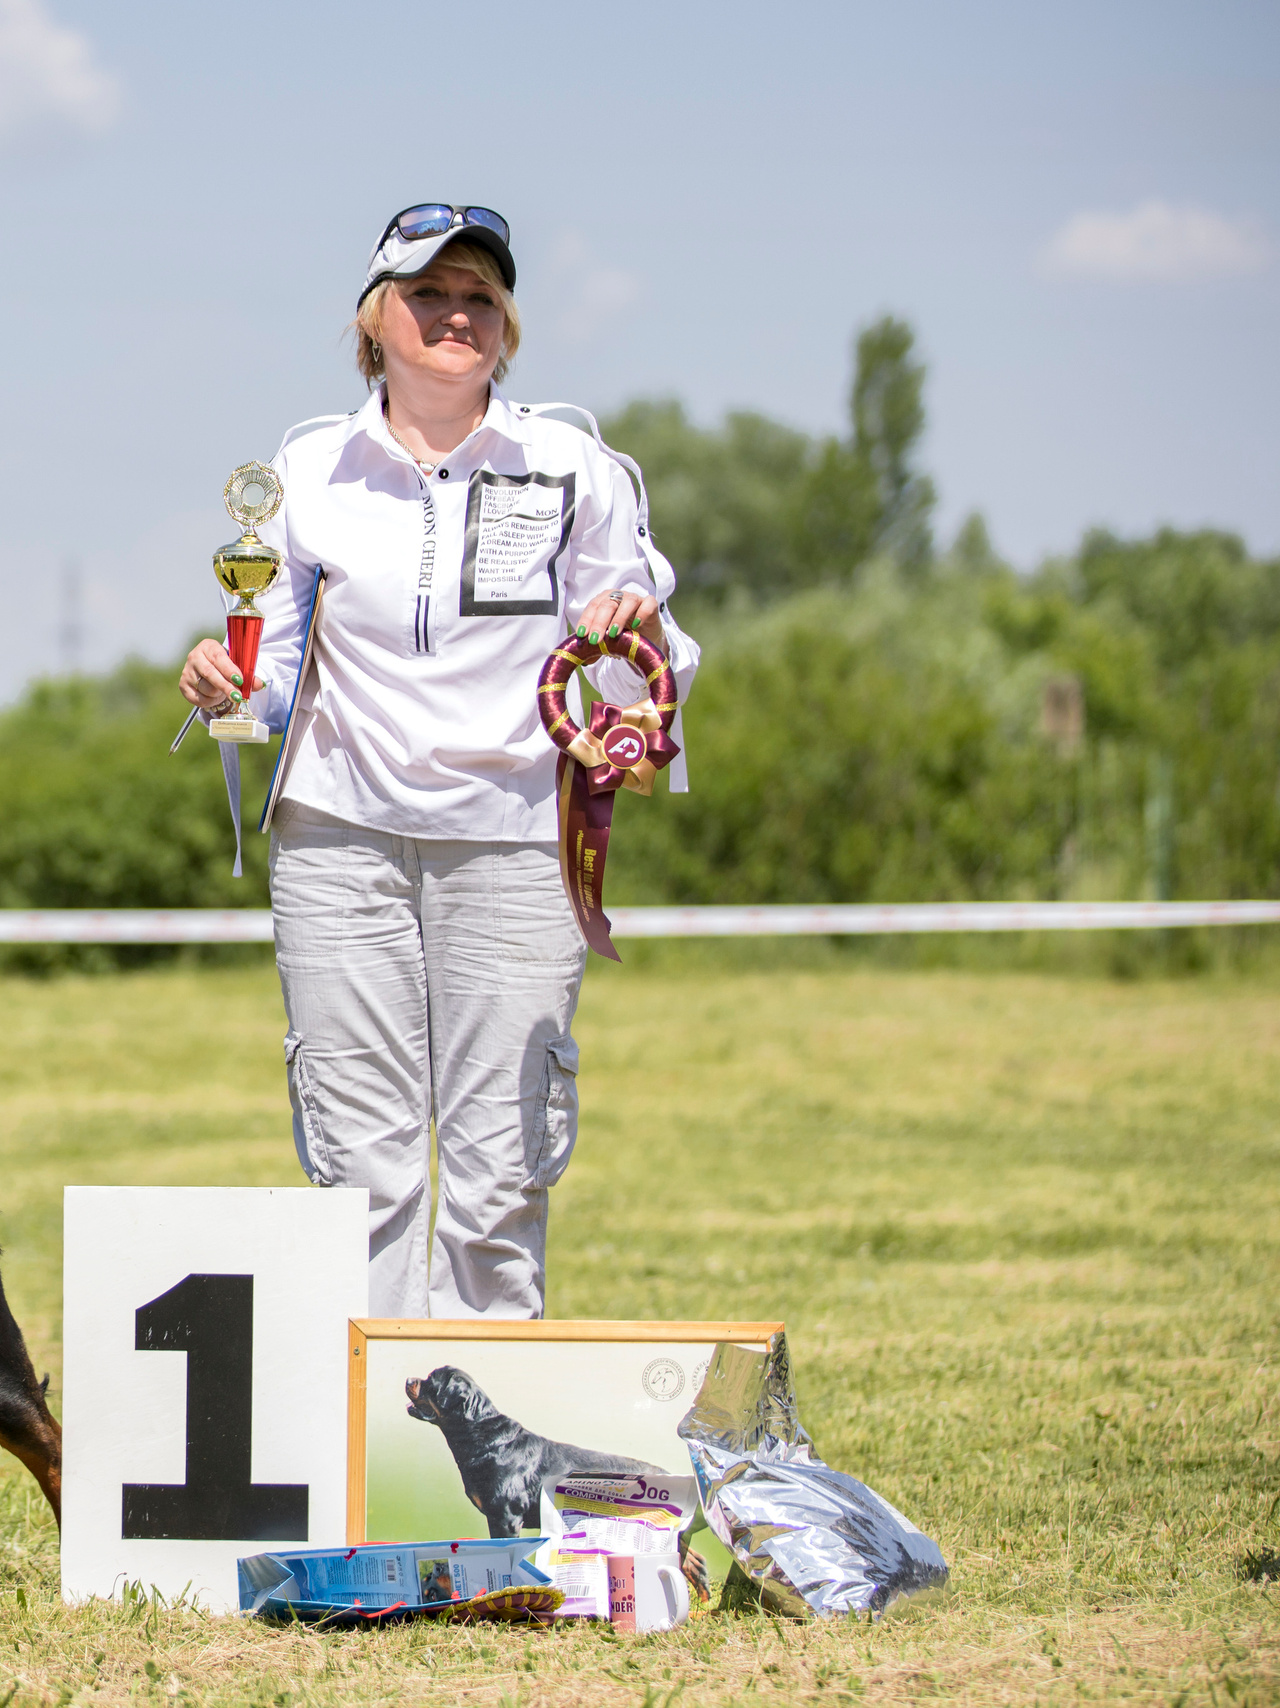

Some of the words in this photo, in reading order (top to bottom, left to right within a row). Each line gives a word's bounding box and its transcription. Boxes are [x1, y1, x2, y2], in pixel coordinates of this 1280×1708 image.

[422, 495, 436, 536] MON
[536, 508, 558, 516] MON
[482, 522, 510, 533] ALWAYS
[511, 522, 549, 531] REMEMBER
[481, 532, 497, 540] FALL
[499, 531, 525, 539] ASLEEP
[487, 539, 512, 547] DREAM
[529, 537, 549, 547] WAKE
[480, 548, 497, 556] WITH
[504, 549, 538, 557] PURPOSE
[418, 540, 436, 589] CHERI
[478, 557, 489, 565] BE
[477, 575, 523, 583] IMPOSSIBLE
[583, 848, 597, 873] Best
[583, 872, 595, 883] in
[583, 884, 595, 909] open
[122, 1273, 309, 1542] 1
[564, 1488, 616, 1504] COMPLEX
[452, 1563, 461, 1578] 500
